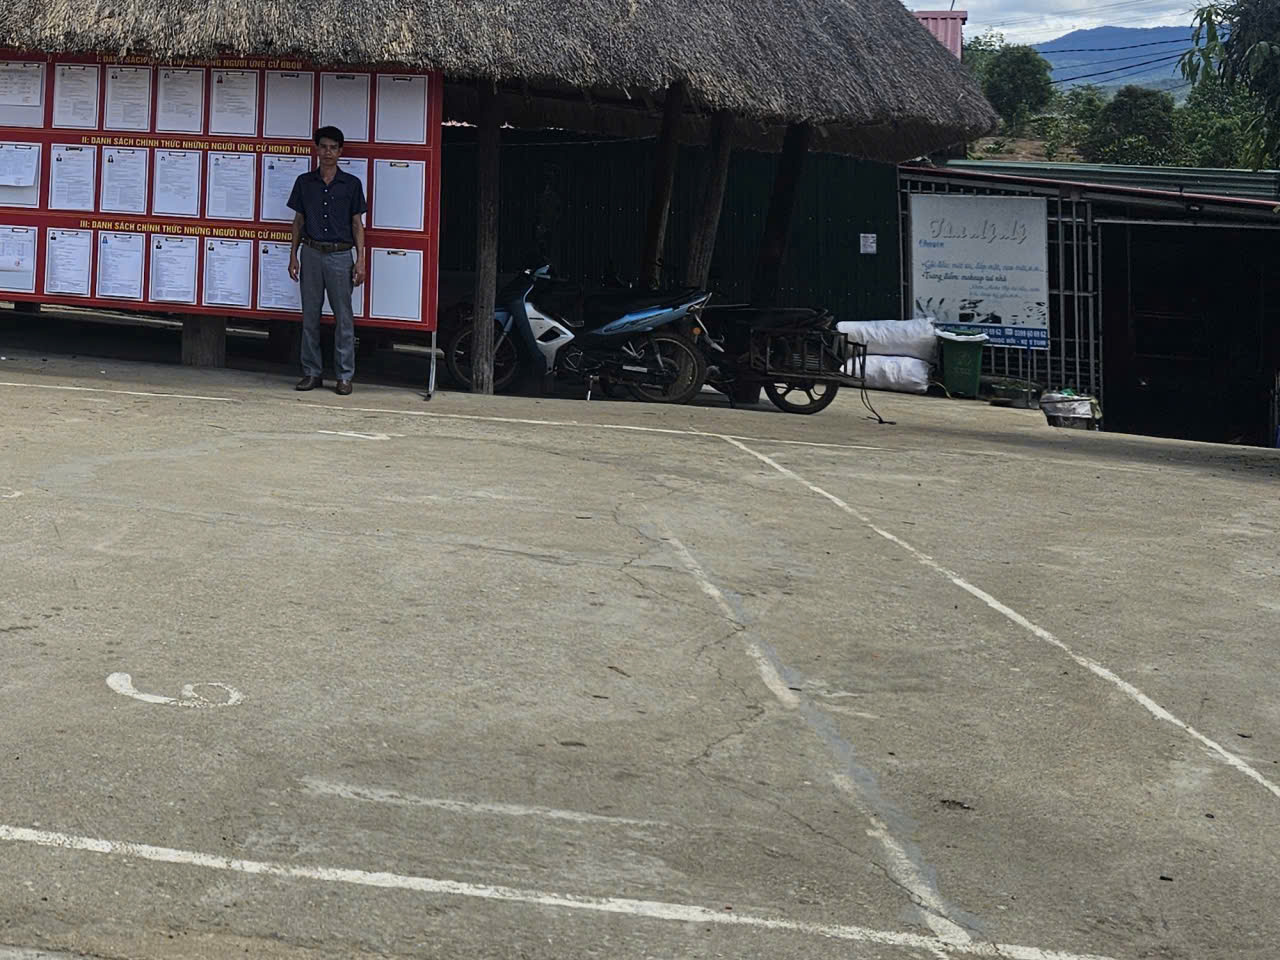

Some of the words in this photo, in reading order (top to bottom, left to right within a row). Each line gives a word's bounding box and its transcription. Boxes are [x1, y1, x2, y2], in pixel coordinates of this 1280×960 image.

[81, 136, 89, 144] II:
[91, 137, 112, 145] DANH
[114, 136, 134, 146] SÁCH
[136, 136, 159, 147] CHÍNH
[161, 138, 180, 148] THỨC
[183, 139, 208, 149] NHỮNG
[211, 141, 235, 151] NGƯỜI
[256, 142, 268, 152] CỬ
[293, 143, 311, 154] TỈNH
[80, 220, 90, 228] III:
[92, 221, 112, 229] DANH
[114, 220, 134, 231] SÁCH
[137, 221, 160, 232] CHÍNH
[163, 223, 182, 233] THỨC
[184, 225, 210, 235] NHỮNG
[212, 226, 237, 237] NGƯỜI
[258, 228, 269, 239] CỬ
